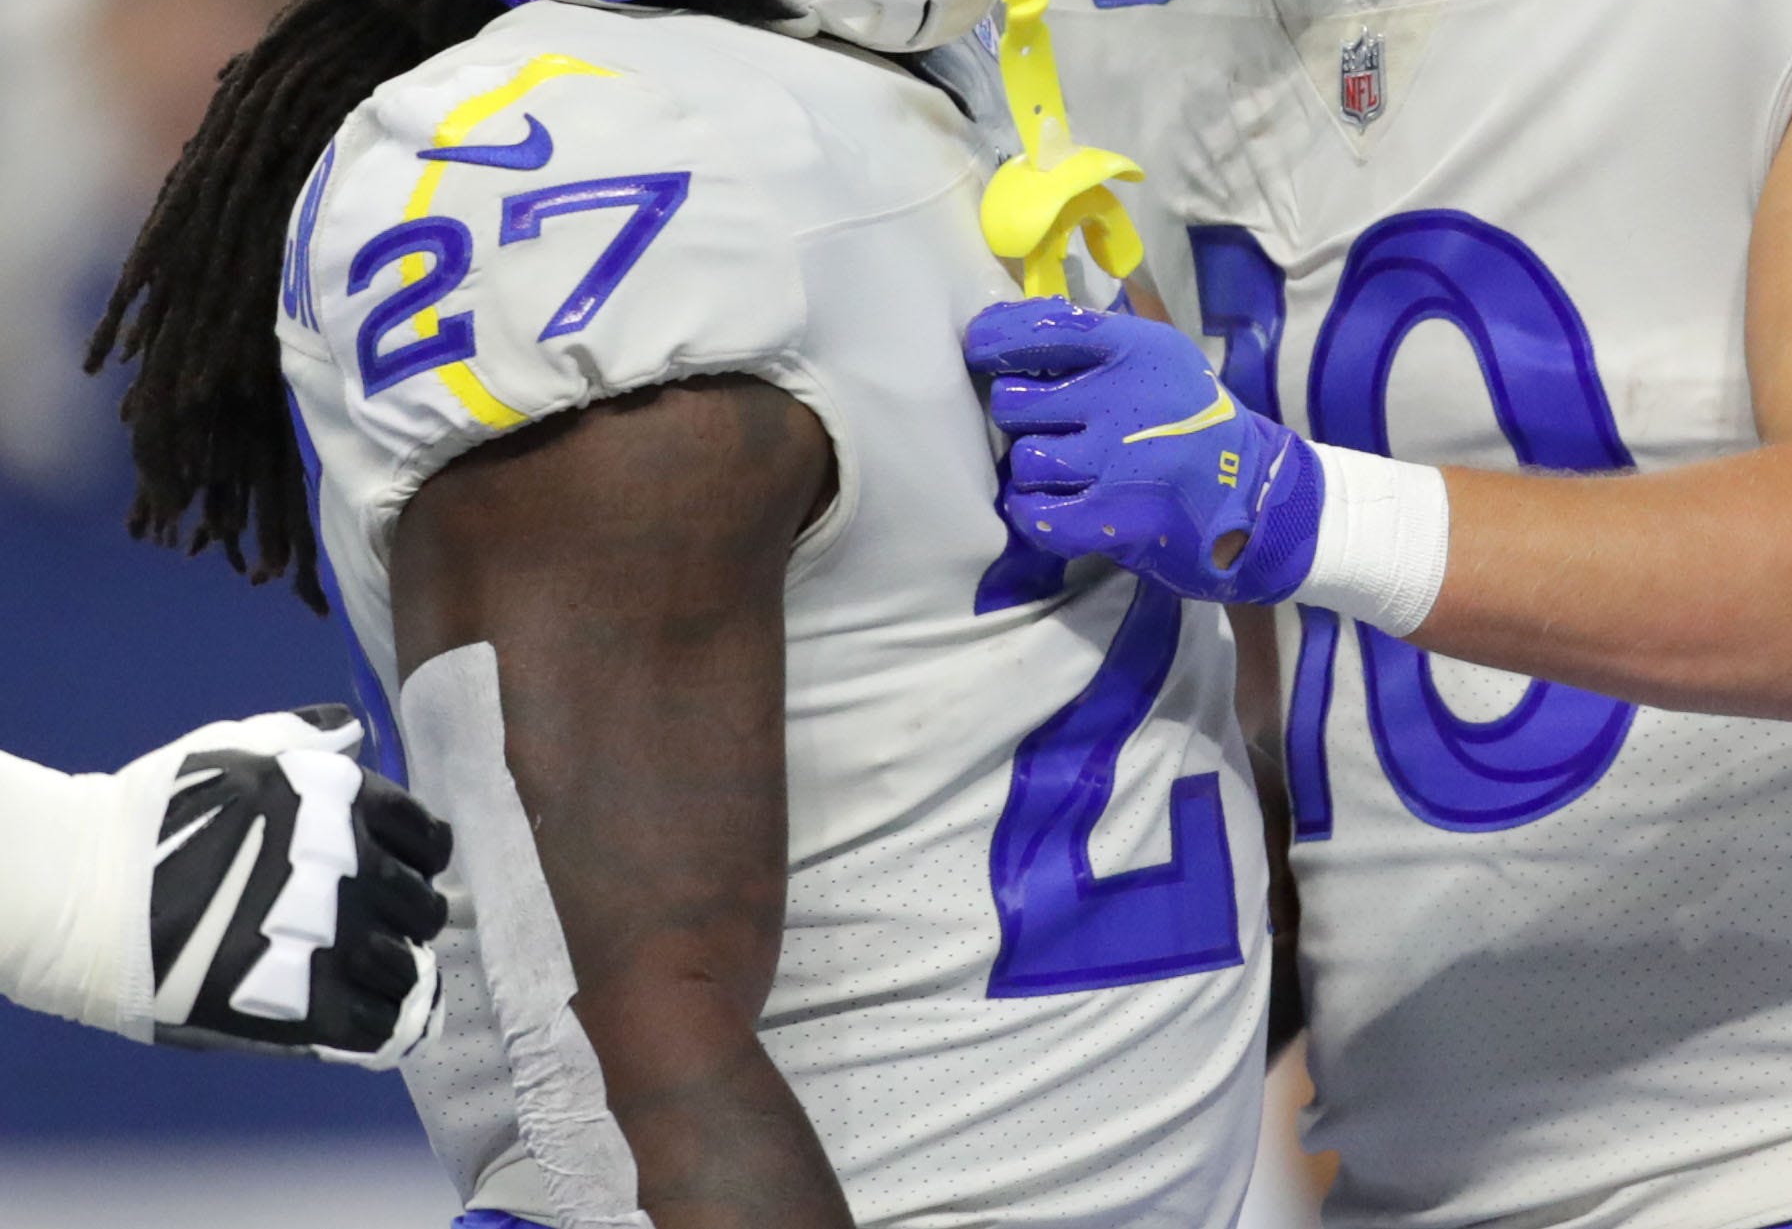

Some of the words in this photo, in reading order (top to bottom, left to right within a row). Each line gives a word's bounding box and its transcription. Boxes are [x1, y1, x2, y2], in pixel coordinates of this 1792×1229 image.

[1344, 74, 1378, 114] NFL
[347, 171, 692, 399] 27
[1187, 208, 1638, 842] 10
[1218, 450, 1240, 489] 10
